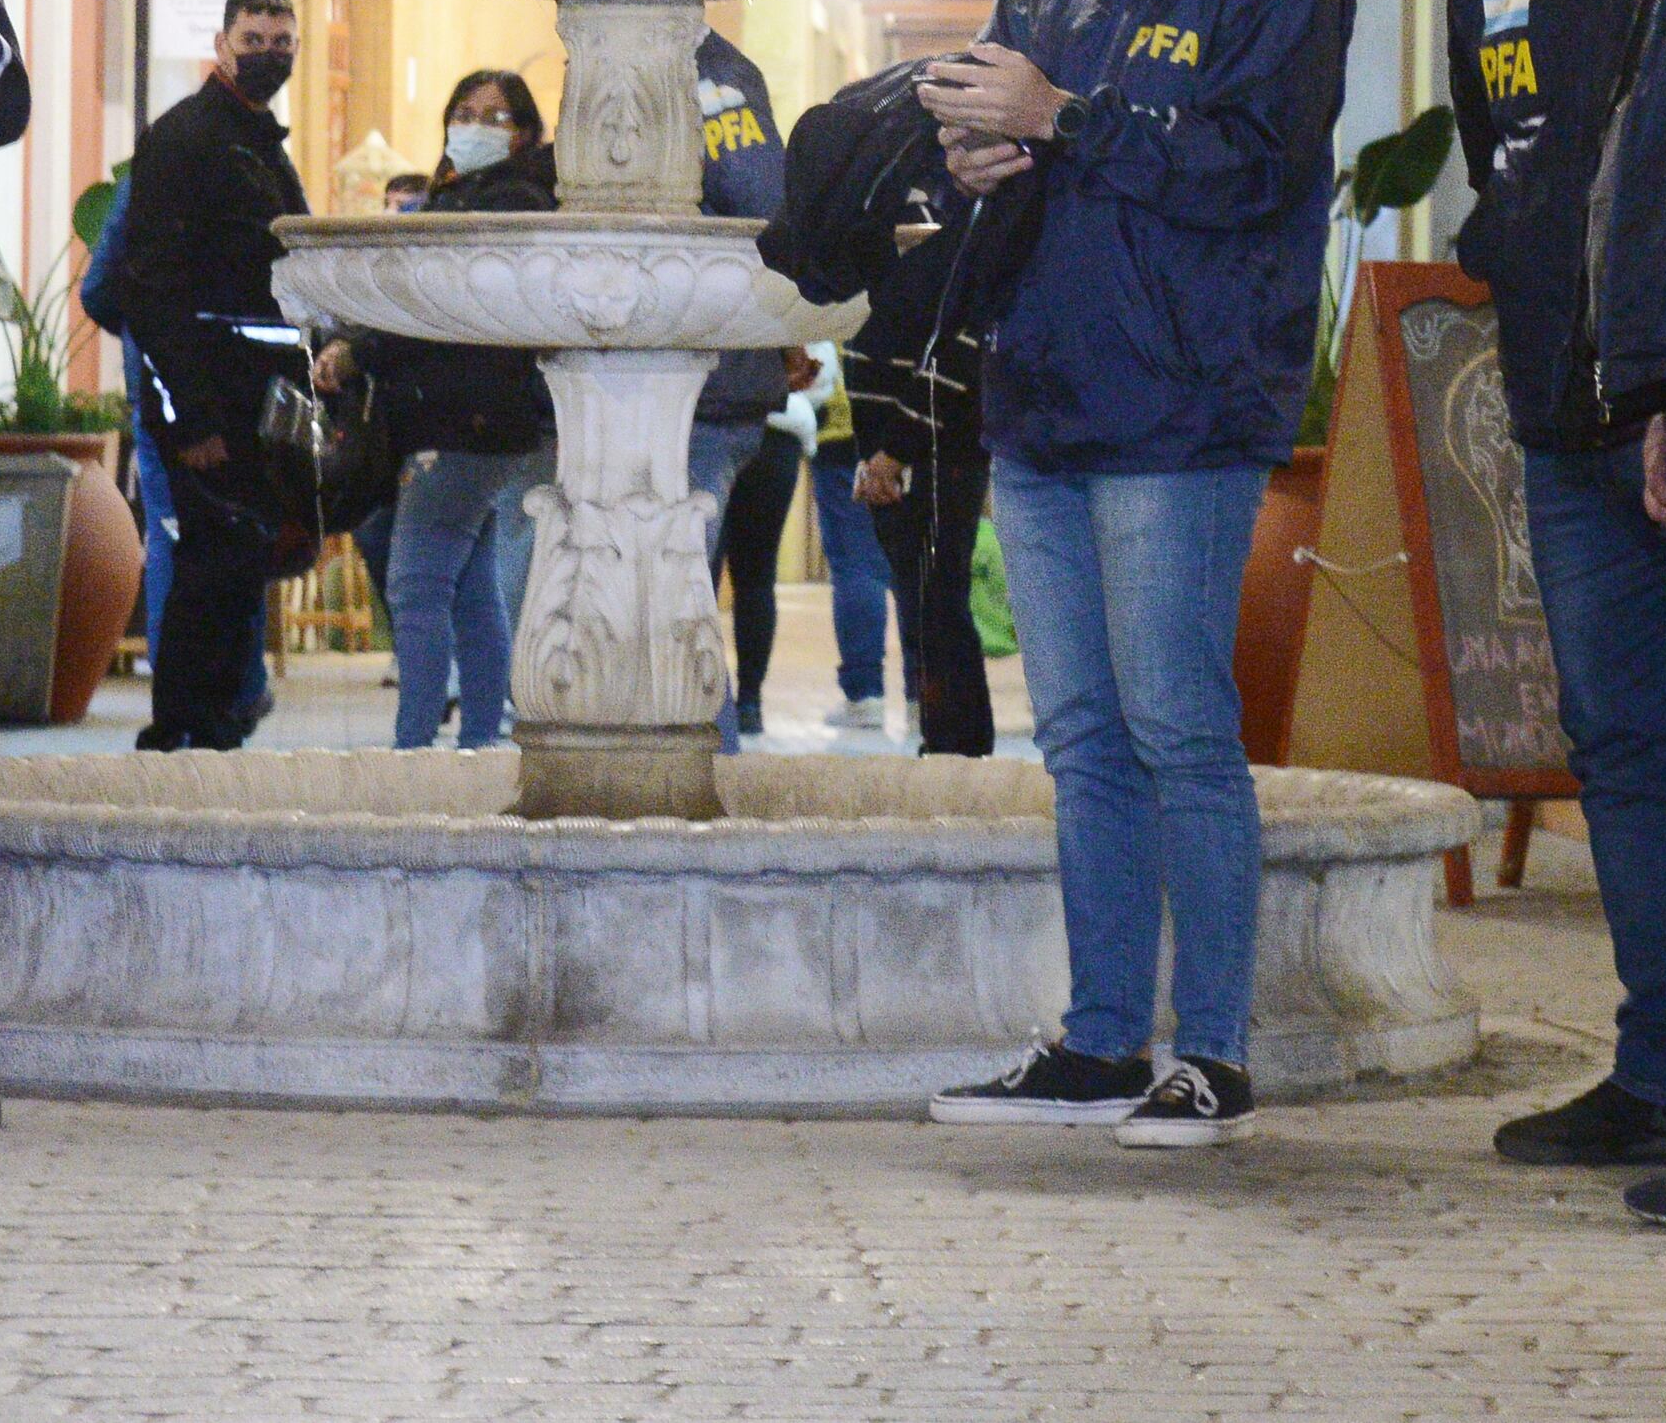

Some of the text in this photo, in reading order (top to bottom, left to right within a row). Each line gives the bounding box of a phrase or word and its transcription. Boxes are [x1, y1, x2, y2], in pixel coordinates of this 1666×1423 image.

[1126, 23, 1200, 67] PFA
[1478, 38, 1538, 102] PFA
[703, 107, 767, 162] PFA
